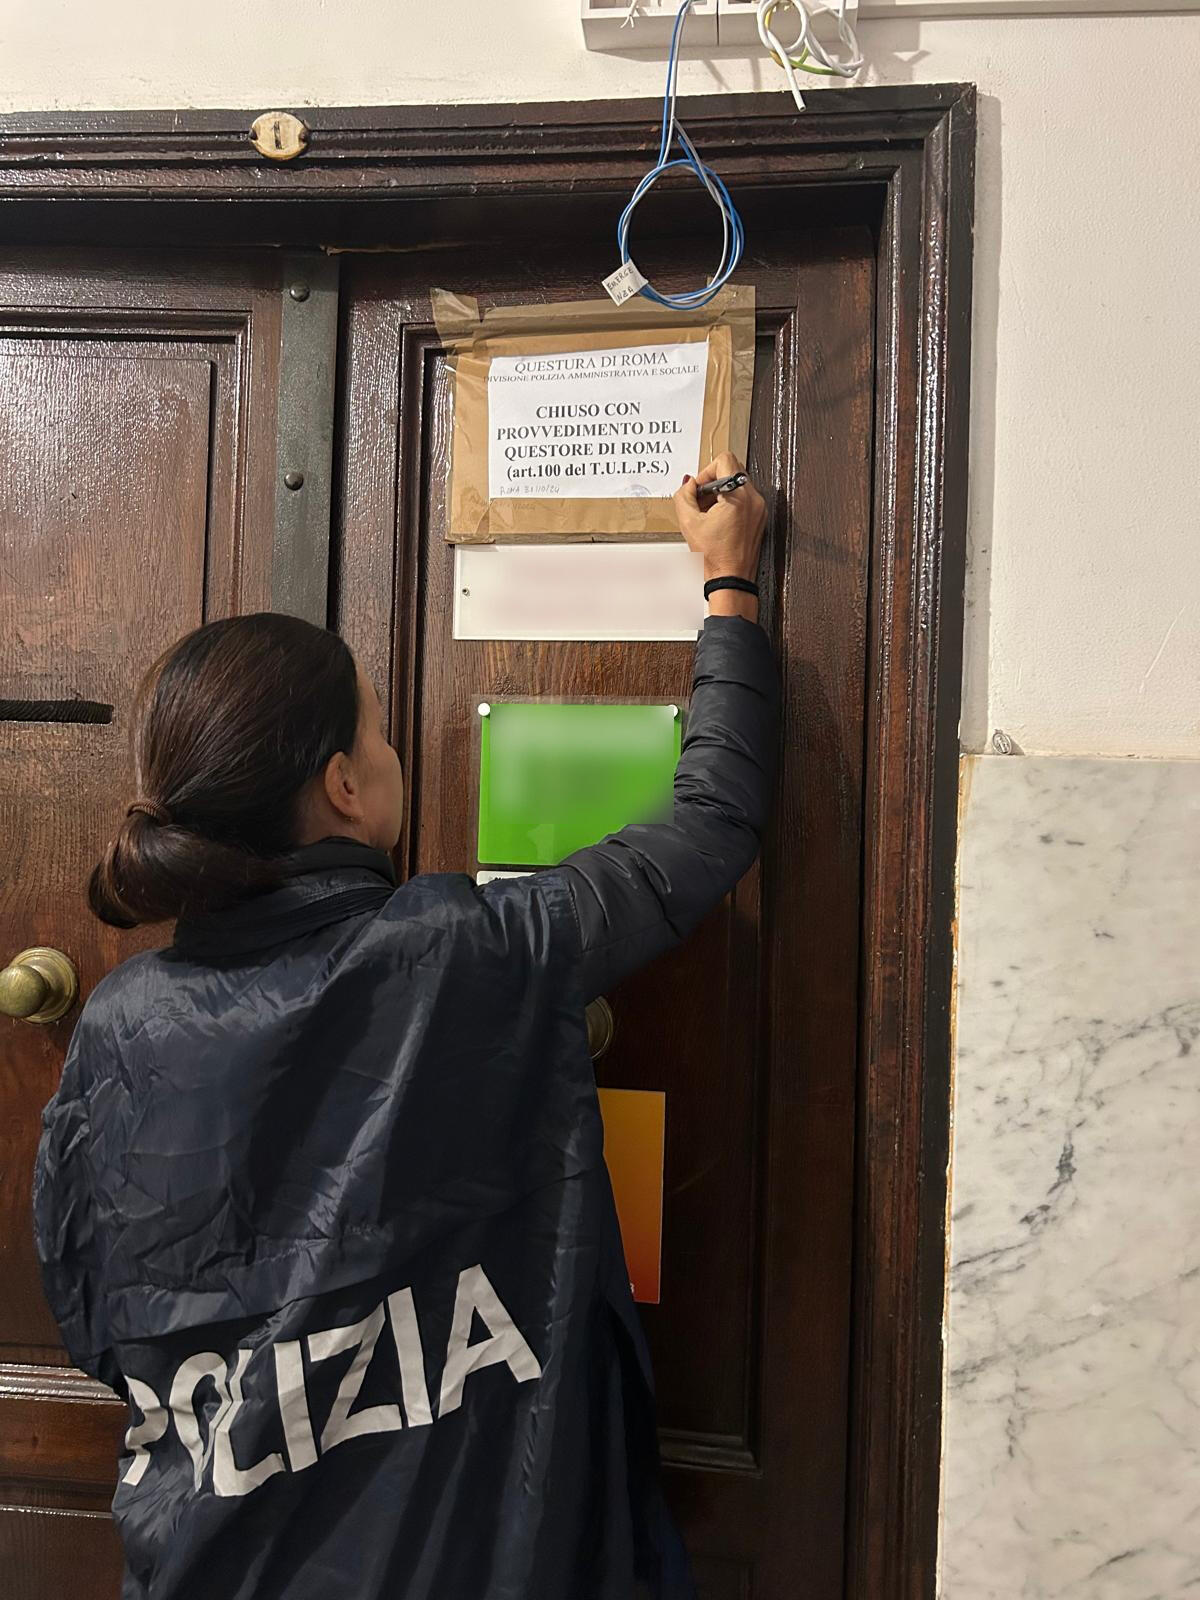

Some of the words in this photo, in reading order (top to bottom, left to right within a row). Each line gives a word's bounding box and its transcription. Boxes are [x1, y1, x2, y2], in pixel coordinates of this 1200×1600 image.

[514, 357, 596, 374] QUESTURA
[601, 355, 617, 368] DI
[621, 352, 668, 367] ROMA
[530, 372, 566, 382] POLIZIA
[567, 369, 649, 380] AMMINISTRATIVA
[651, 368, 658, 376] E
[659, 365, 700, 376] SOCIALE
[535, 403, 600, 419] CHIUSO
[604, 401, 641, 416] CON
[497, 421, 644, 440] PROVVEDIMENTO
[648, 420, 682, 434] DEL
[504, 443, 594, 461] QUESTORE
[598, 442, 616, 455] DI
[621, 440, 673, 455] ROMA
[507, 464, 561, 481] (art.100
[565, 463, 586, 476] del
[589, 460, 670, 476] T.U.L.P.S.)
[122, 1263, 542, 1498] POLIZIA
